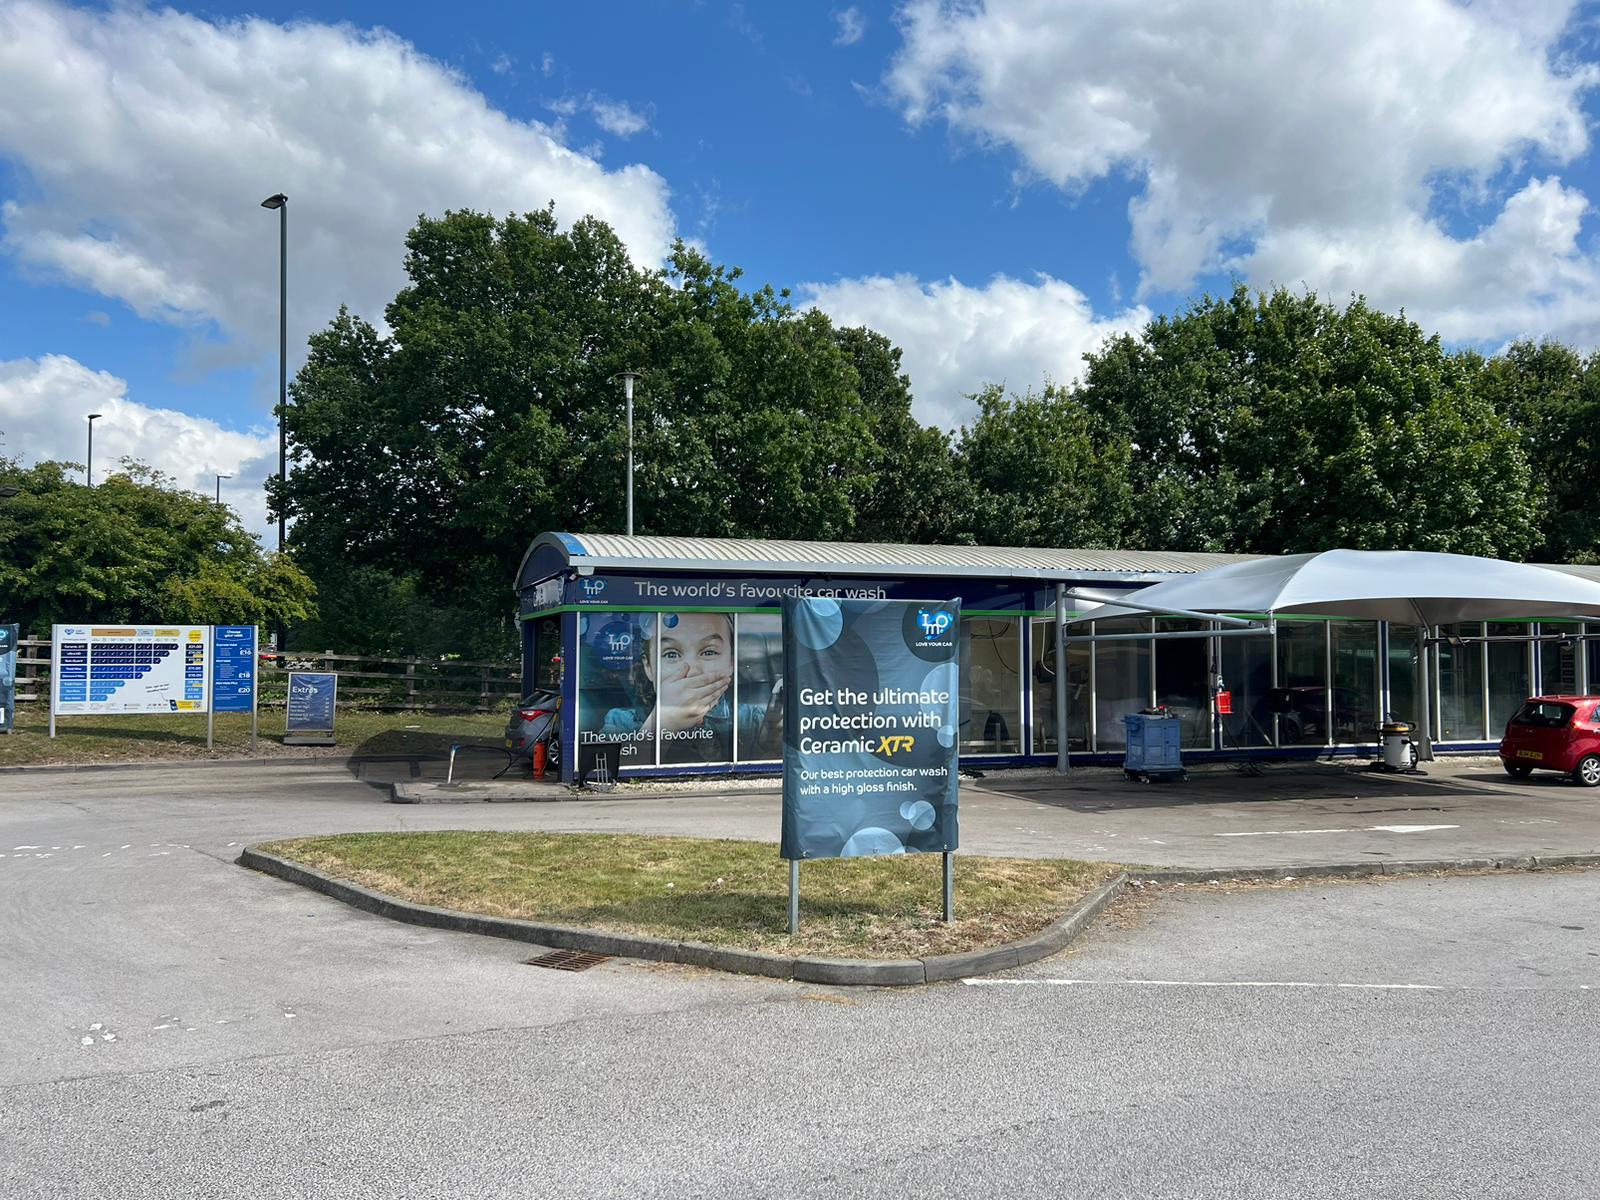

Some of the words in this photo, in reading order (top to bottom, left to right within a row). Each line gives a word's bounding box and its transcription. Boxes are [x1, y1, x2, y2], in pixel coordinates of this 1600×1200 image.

[634, 581, 677, 597] The
[681, 581, 736, 597] world's
[739, 582, 814, 598] favourite
[816, 587, 842, 598] car
[844, 584, 886, 600] wash
[292, 686, 319, 694] Extras
[800, 688, 833, 705] Get
[837, 689, 869, 705] the
[873, 689, 949, 705] ultimate
[800, 713, 897, 733] protection
[902, 713, 941, 728] with
[581, 731, 606, 743] The
[609, 729, 655, 742] world's
[661, 728, 713, 740] favourite
[800, 736, 875, 754] Ceramic
[876, 736, 915, 756] XTR
[800, 770, 818, 780] Our
[820, 768, 844, 779] best
[846, 767, 899, 779] protection
[901, 768, 918, 777] car
[919, 767, 948, 777] wash
[800, 783, 821, 795] with
[823, 785, 830, 794] a
[832, 782, 854, 796] high
[857, 782, 884, 795] gloss
[886, 781, 917, 792] finish.
